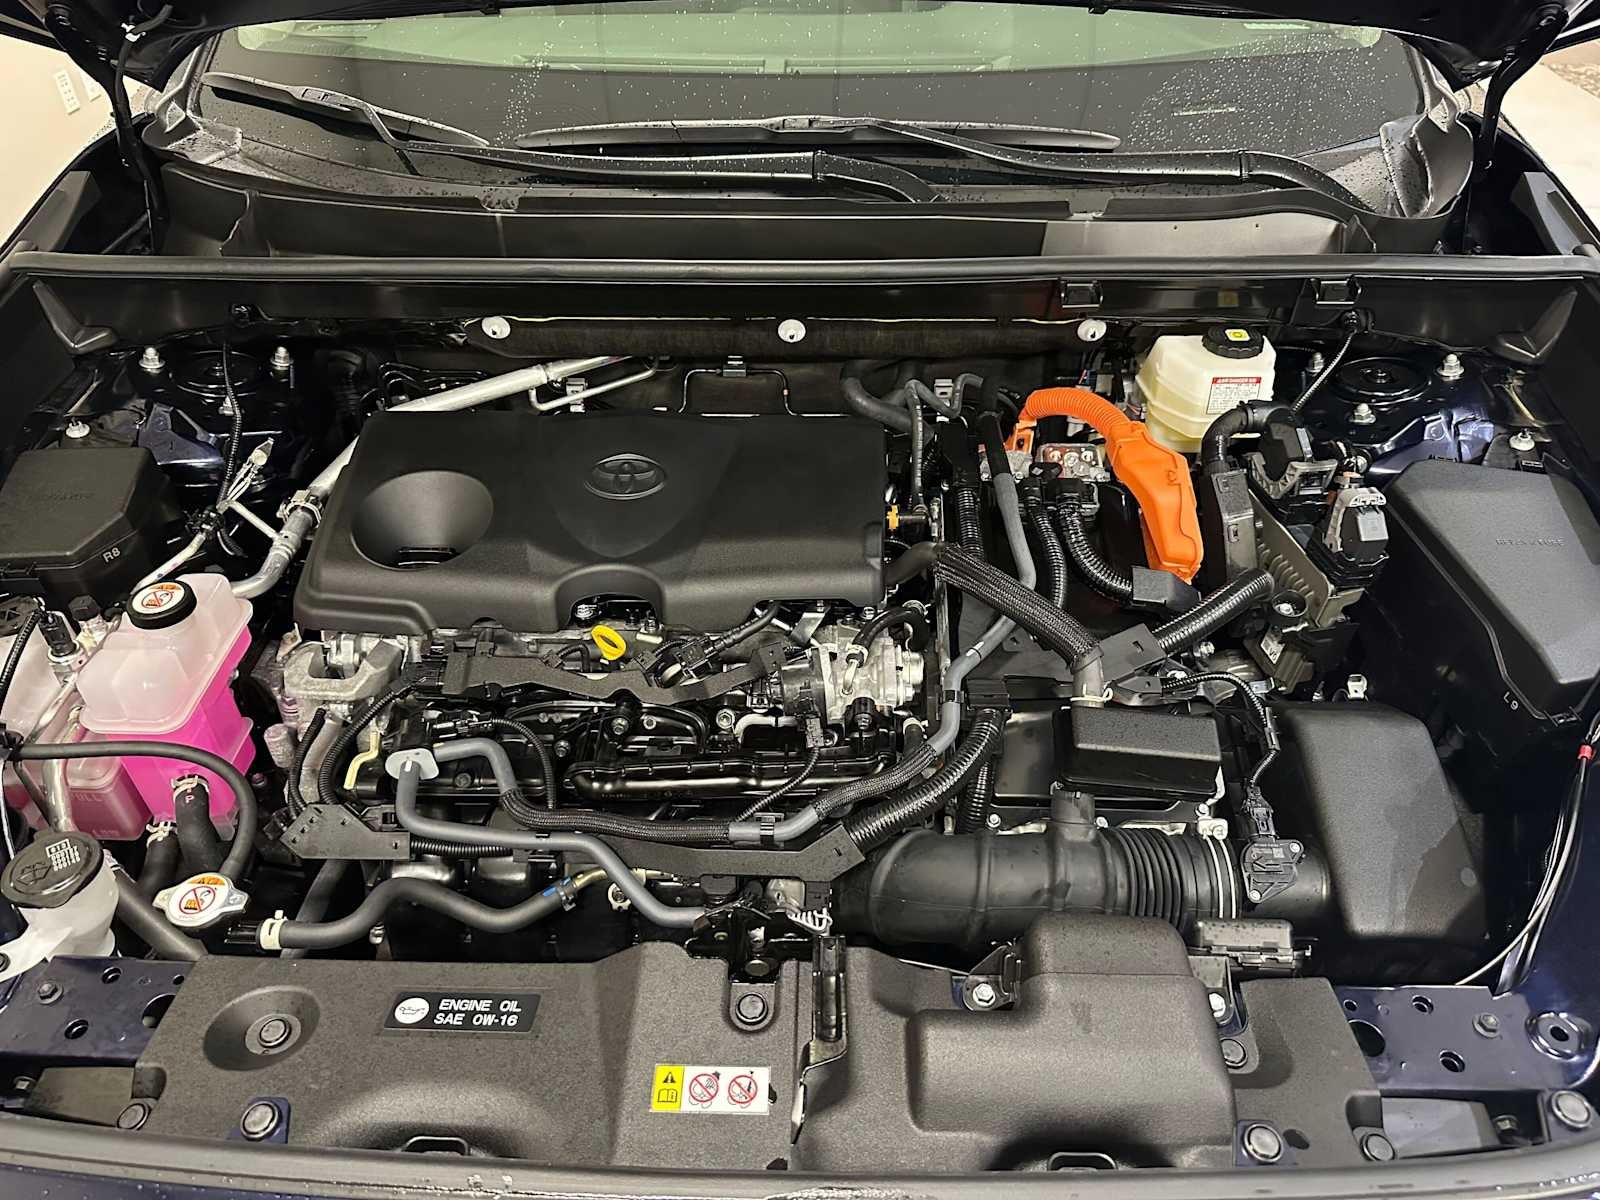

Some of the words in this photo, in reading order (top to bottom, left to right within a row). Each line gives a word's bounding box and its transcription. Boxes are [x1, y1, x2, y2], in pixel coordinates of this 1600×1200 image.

[102, 547, 121, 563] R8
[1503, 691, 1519, 710] L9
[438, 998, 493, 1012] ENGINE
[499, 1000, 522, 1013] OIL
[433, 1013, 466, 1026] SAE
[472, 1014, 519, 1027] 0W-16
